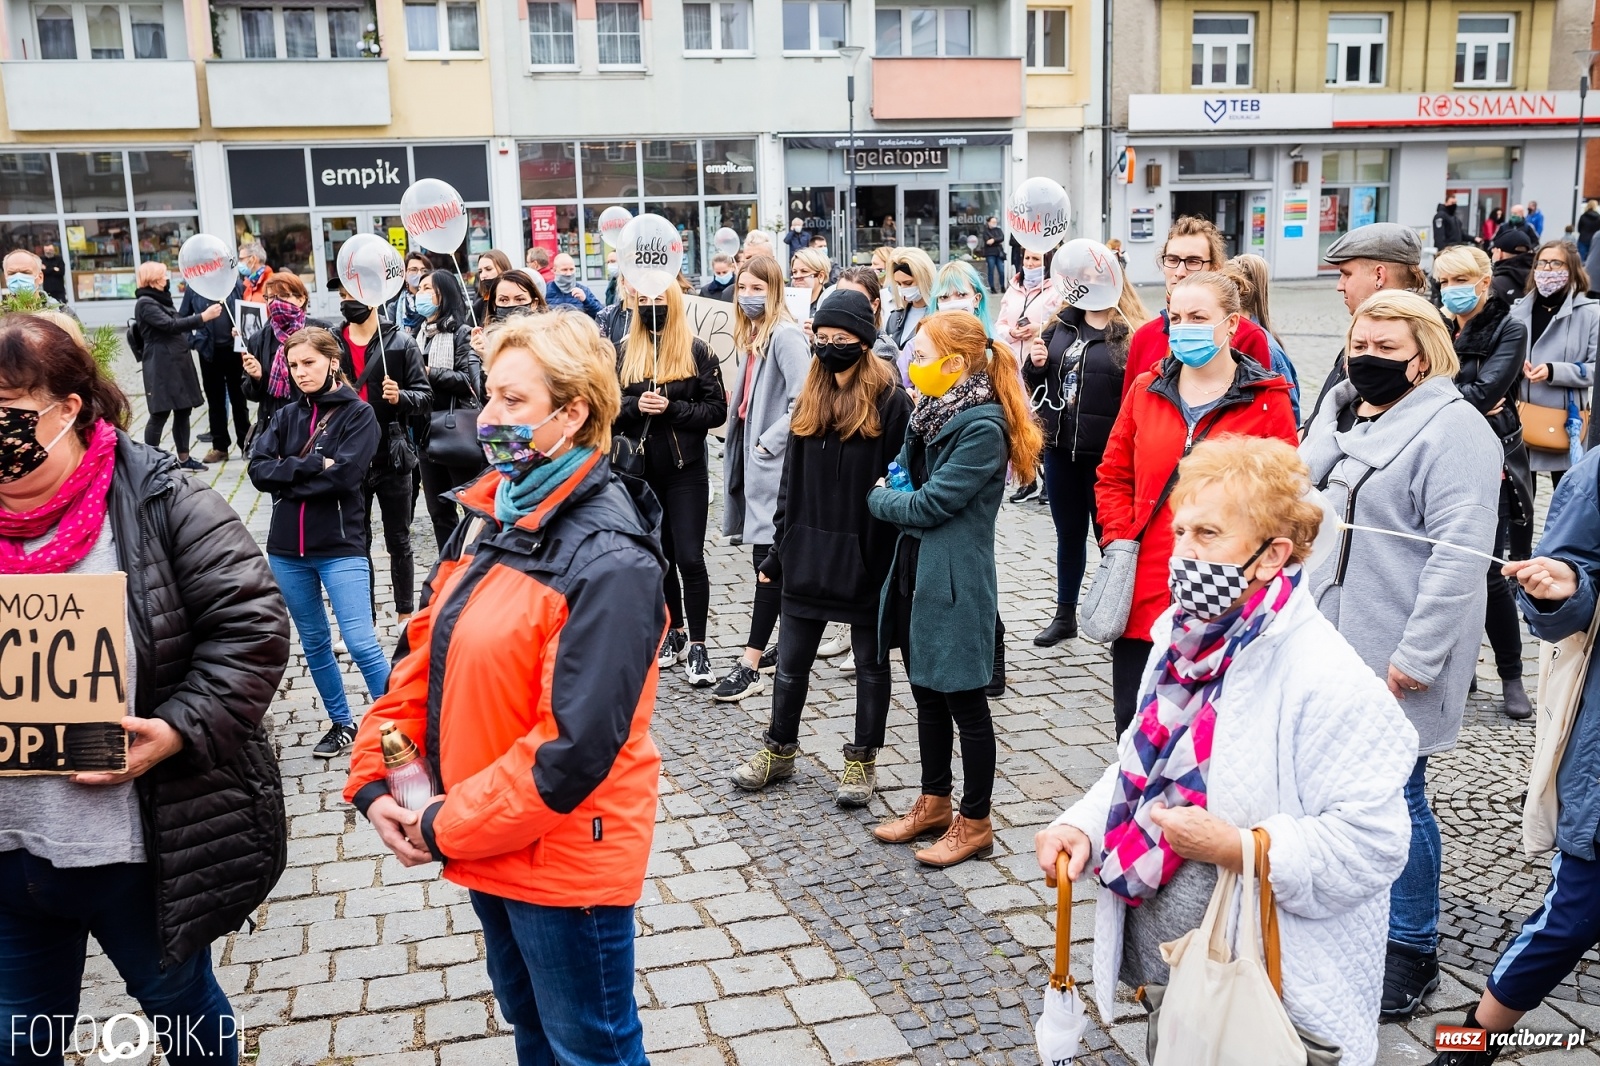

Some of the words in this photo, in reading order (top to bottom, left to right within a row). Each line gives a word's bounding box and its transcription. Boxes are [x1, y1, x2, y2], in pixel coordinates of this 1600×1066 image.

[1230, 99, 1260, 112] TEB
[1418, 95, 1557, 117] ROSSMANN
[321, 158, 401, 190] empik
[705, 160, 755, 175] empik.com
[1043, 220, 1068, 238] 2020
[636, 236, 667, 253] hello
[635, 252, 668, 265] 2020
[1064, 284, 1090, 305] 2020
[0, 593, 85, 622] MOJA
